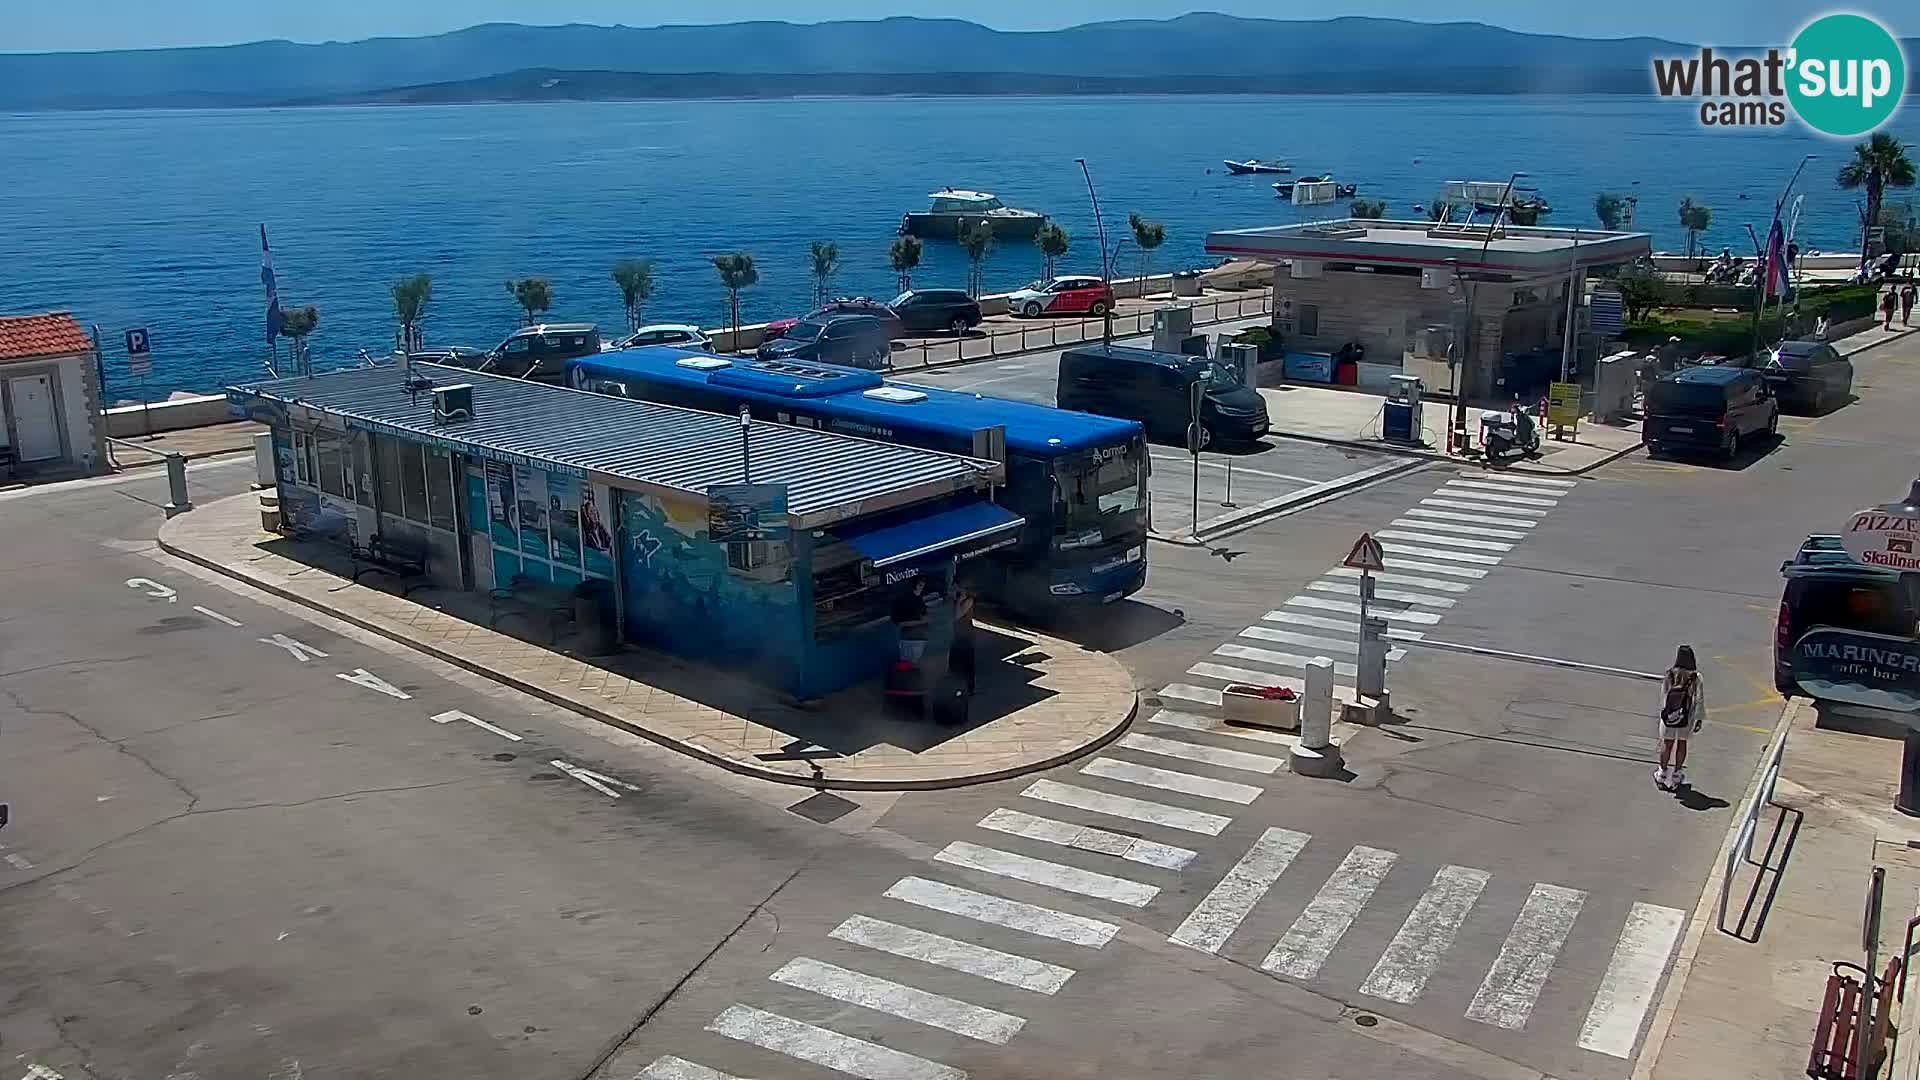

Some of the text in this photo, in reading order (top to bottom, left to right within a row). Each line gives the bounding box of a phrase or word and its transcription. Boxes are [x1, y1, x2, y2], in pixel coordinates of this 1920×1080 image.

[131, 332, 143, 350] P
[480, 447, 494, 459] BUS
[495, 450, 527, 465] STATION
[529, 458, 555, 473] TICKET
[556, 465, 584, 478] OFFICE
[1803, 643, 1920, 673] MARINER
[1873, 666, 1900, 681] bar
